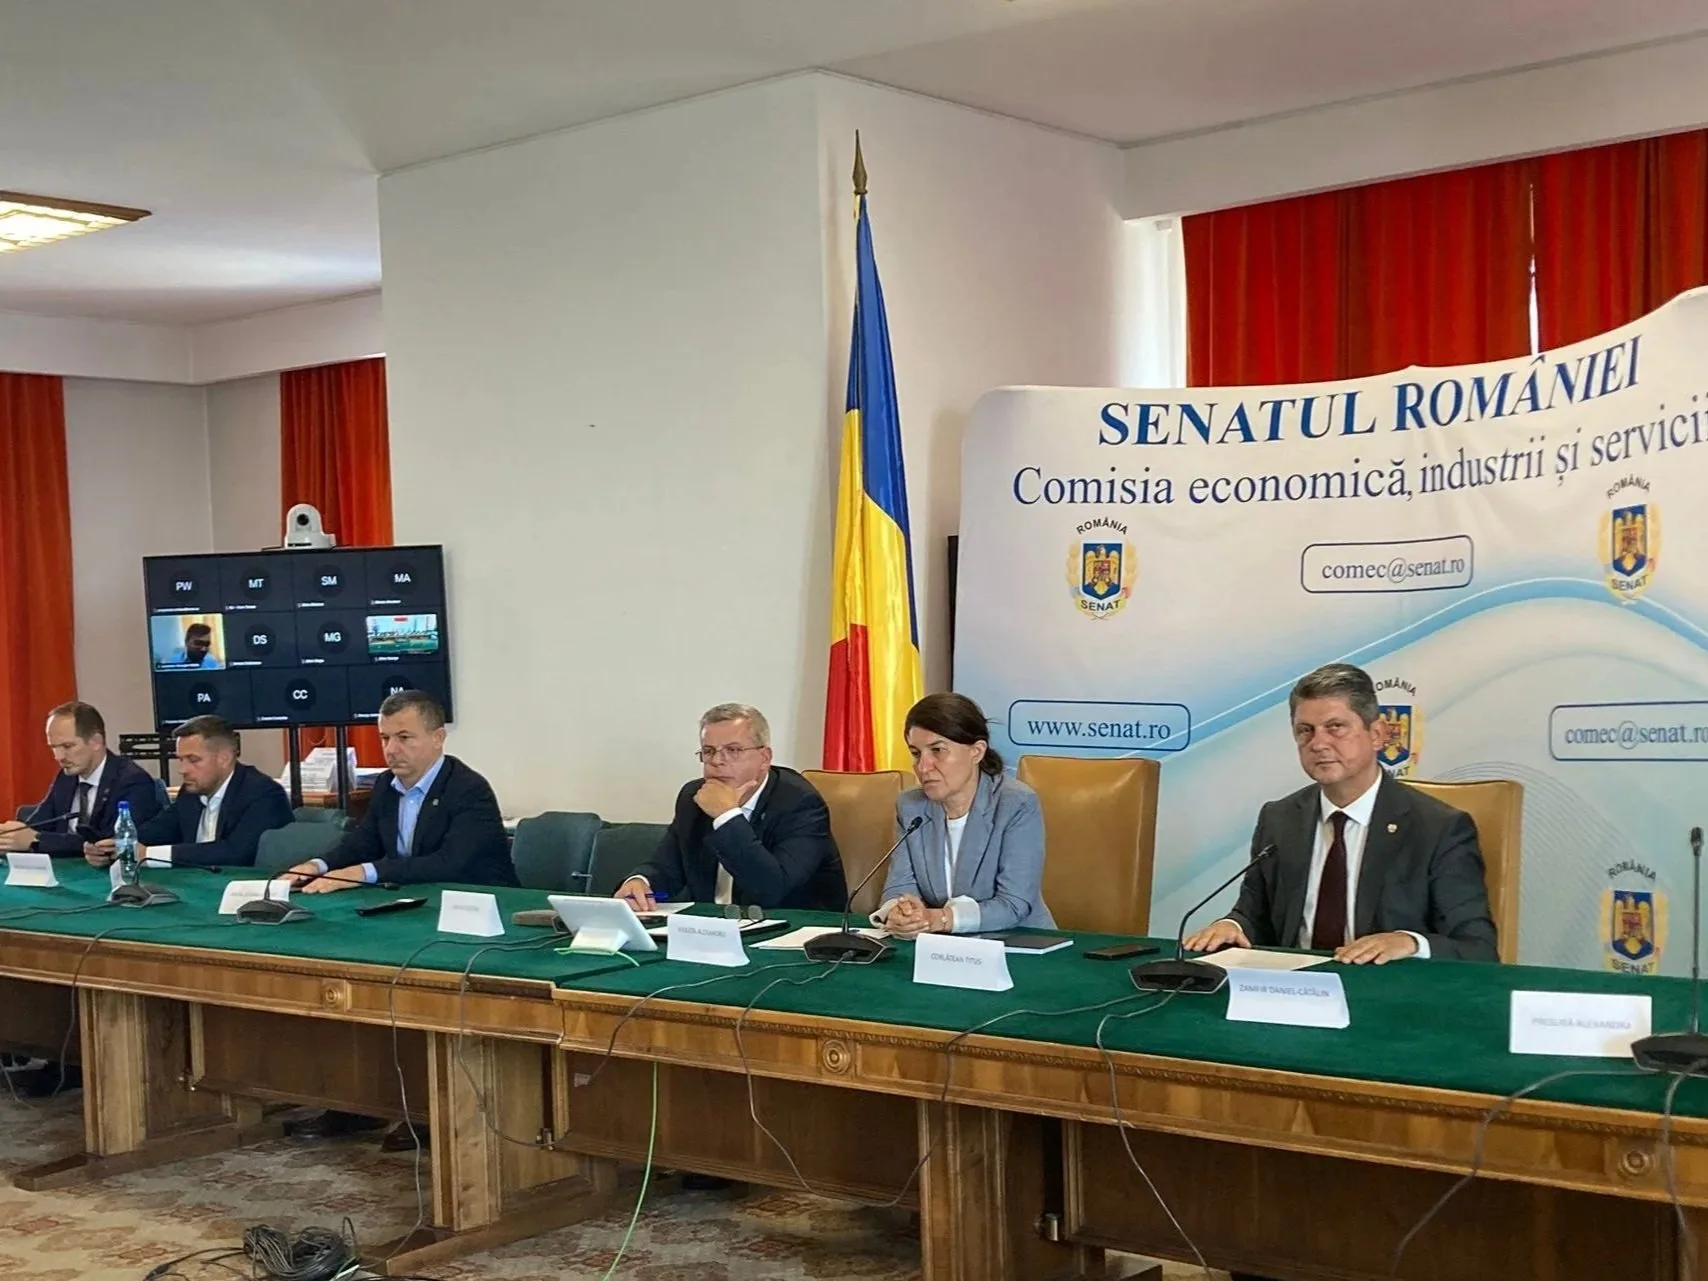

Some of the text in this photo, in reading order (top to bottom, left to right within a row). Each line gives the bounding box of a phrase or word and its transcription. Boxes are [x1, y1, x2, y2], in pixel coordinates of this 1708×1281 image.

[1098, 334, 1642, 446] SENATUL ROMÂNIEI
[1012, 466, 1175, 505] Comisia
[1188, 457, 1413, 505] economică,
[1419, 435, 1546, 494] industrii
[1555, 427, 1582, 487] și
[1606, 473, 1651, 499] ROMÂNIA
[1076, 516, 1128, 535] ROMÂNIA
[394, 573, 412, 583] MA
[1322, 557, 1465, 584] comec@senat.ro
[176, 581, 193, 591] PW
[248, 578, 265, 589] MT
[321, 575, 338, 586] SM
[1611, 574, 1648, 591] SENAT
[1081, 599, 1121, 612] SENAT
[253, 634, 268, 645] DS
[324, 632, 342, 643] MG
[292, 689, 308, 700] CC
[1375, 677, 1417, 697] OMÂNIA
[197, 693, 211, 703] PA
[1028, 719, 1171, 739] www.senat.ro
[1565, 720, 1708, 750] comec@senat.ro
[1608, 859, 1657, 880] ROMÂNIA
[1611, 958, 1655, 974] SENAT
